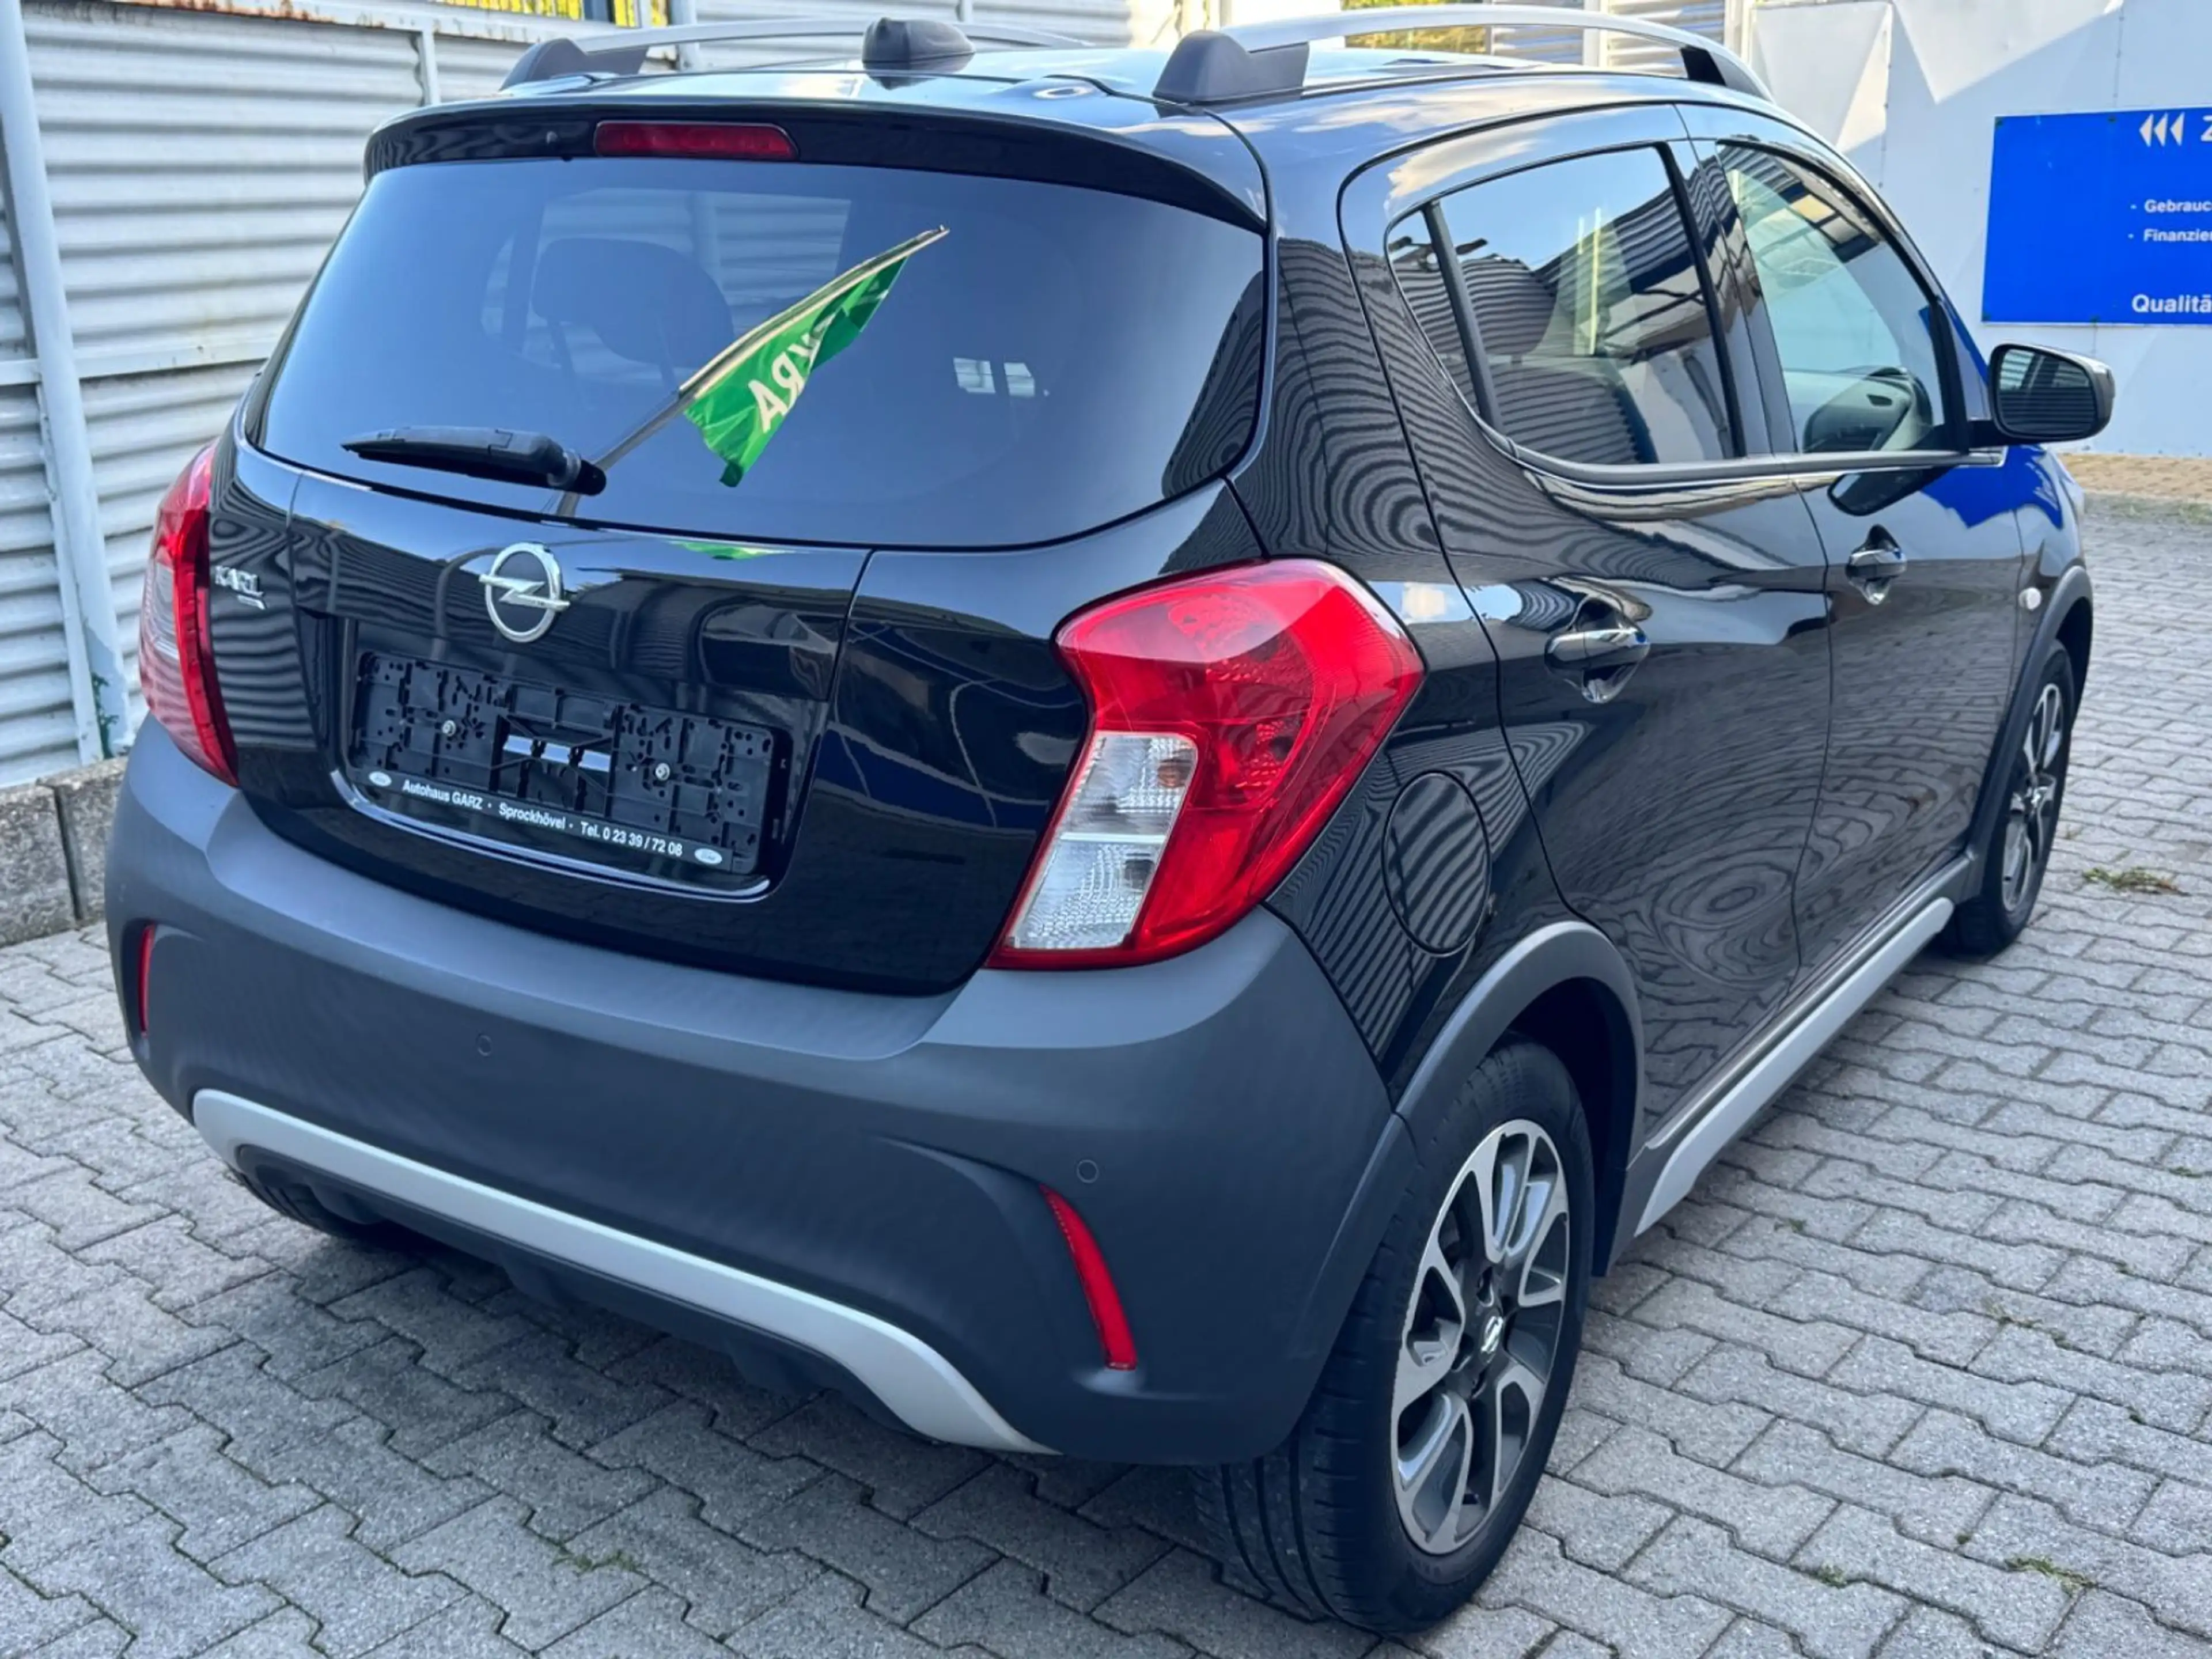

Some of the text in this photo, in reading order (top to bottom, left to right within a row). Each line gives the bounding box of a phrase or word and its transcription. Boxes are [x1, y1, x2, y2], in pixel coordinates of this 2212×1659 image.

[2131, 293, 2212, 313] Qualitä
[402, 779, 450, 802] Autohaus
[452, 791, 483, 810] GARZ
[498, 802, 566, 830] Sprockhövel
[580, 820, 601, 838] Tel.
[602, 827, 610, 840] 0
[612, 829, 627, 843] 23
[628, 832, 643, 847] 39
[652, 838, 666, 853] 72
